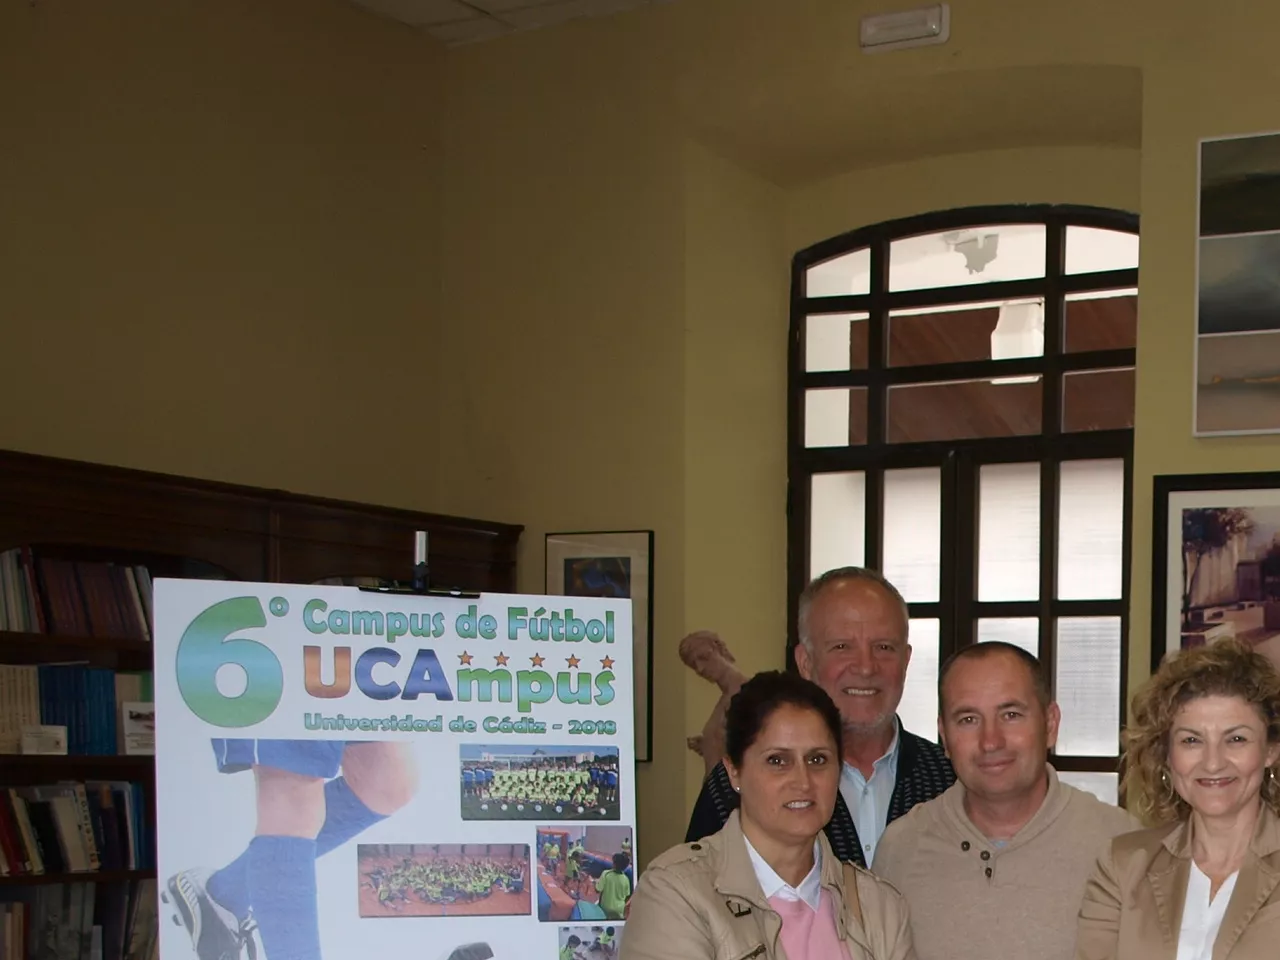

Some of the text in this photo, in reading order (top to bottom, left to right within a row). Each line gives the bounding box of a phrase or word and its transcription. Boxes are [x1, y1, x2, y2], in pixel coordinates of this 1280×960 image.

[302, 598, 615, 644] Campus de Fútbol
[303, 645, 616, 712] UCAmpus
[304, 712, 443, 733] Universidad
[448, 715, 477, 733] de
[482, 715, 546, 734] Cádiz
[568, 719, 617, 735] 2018
